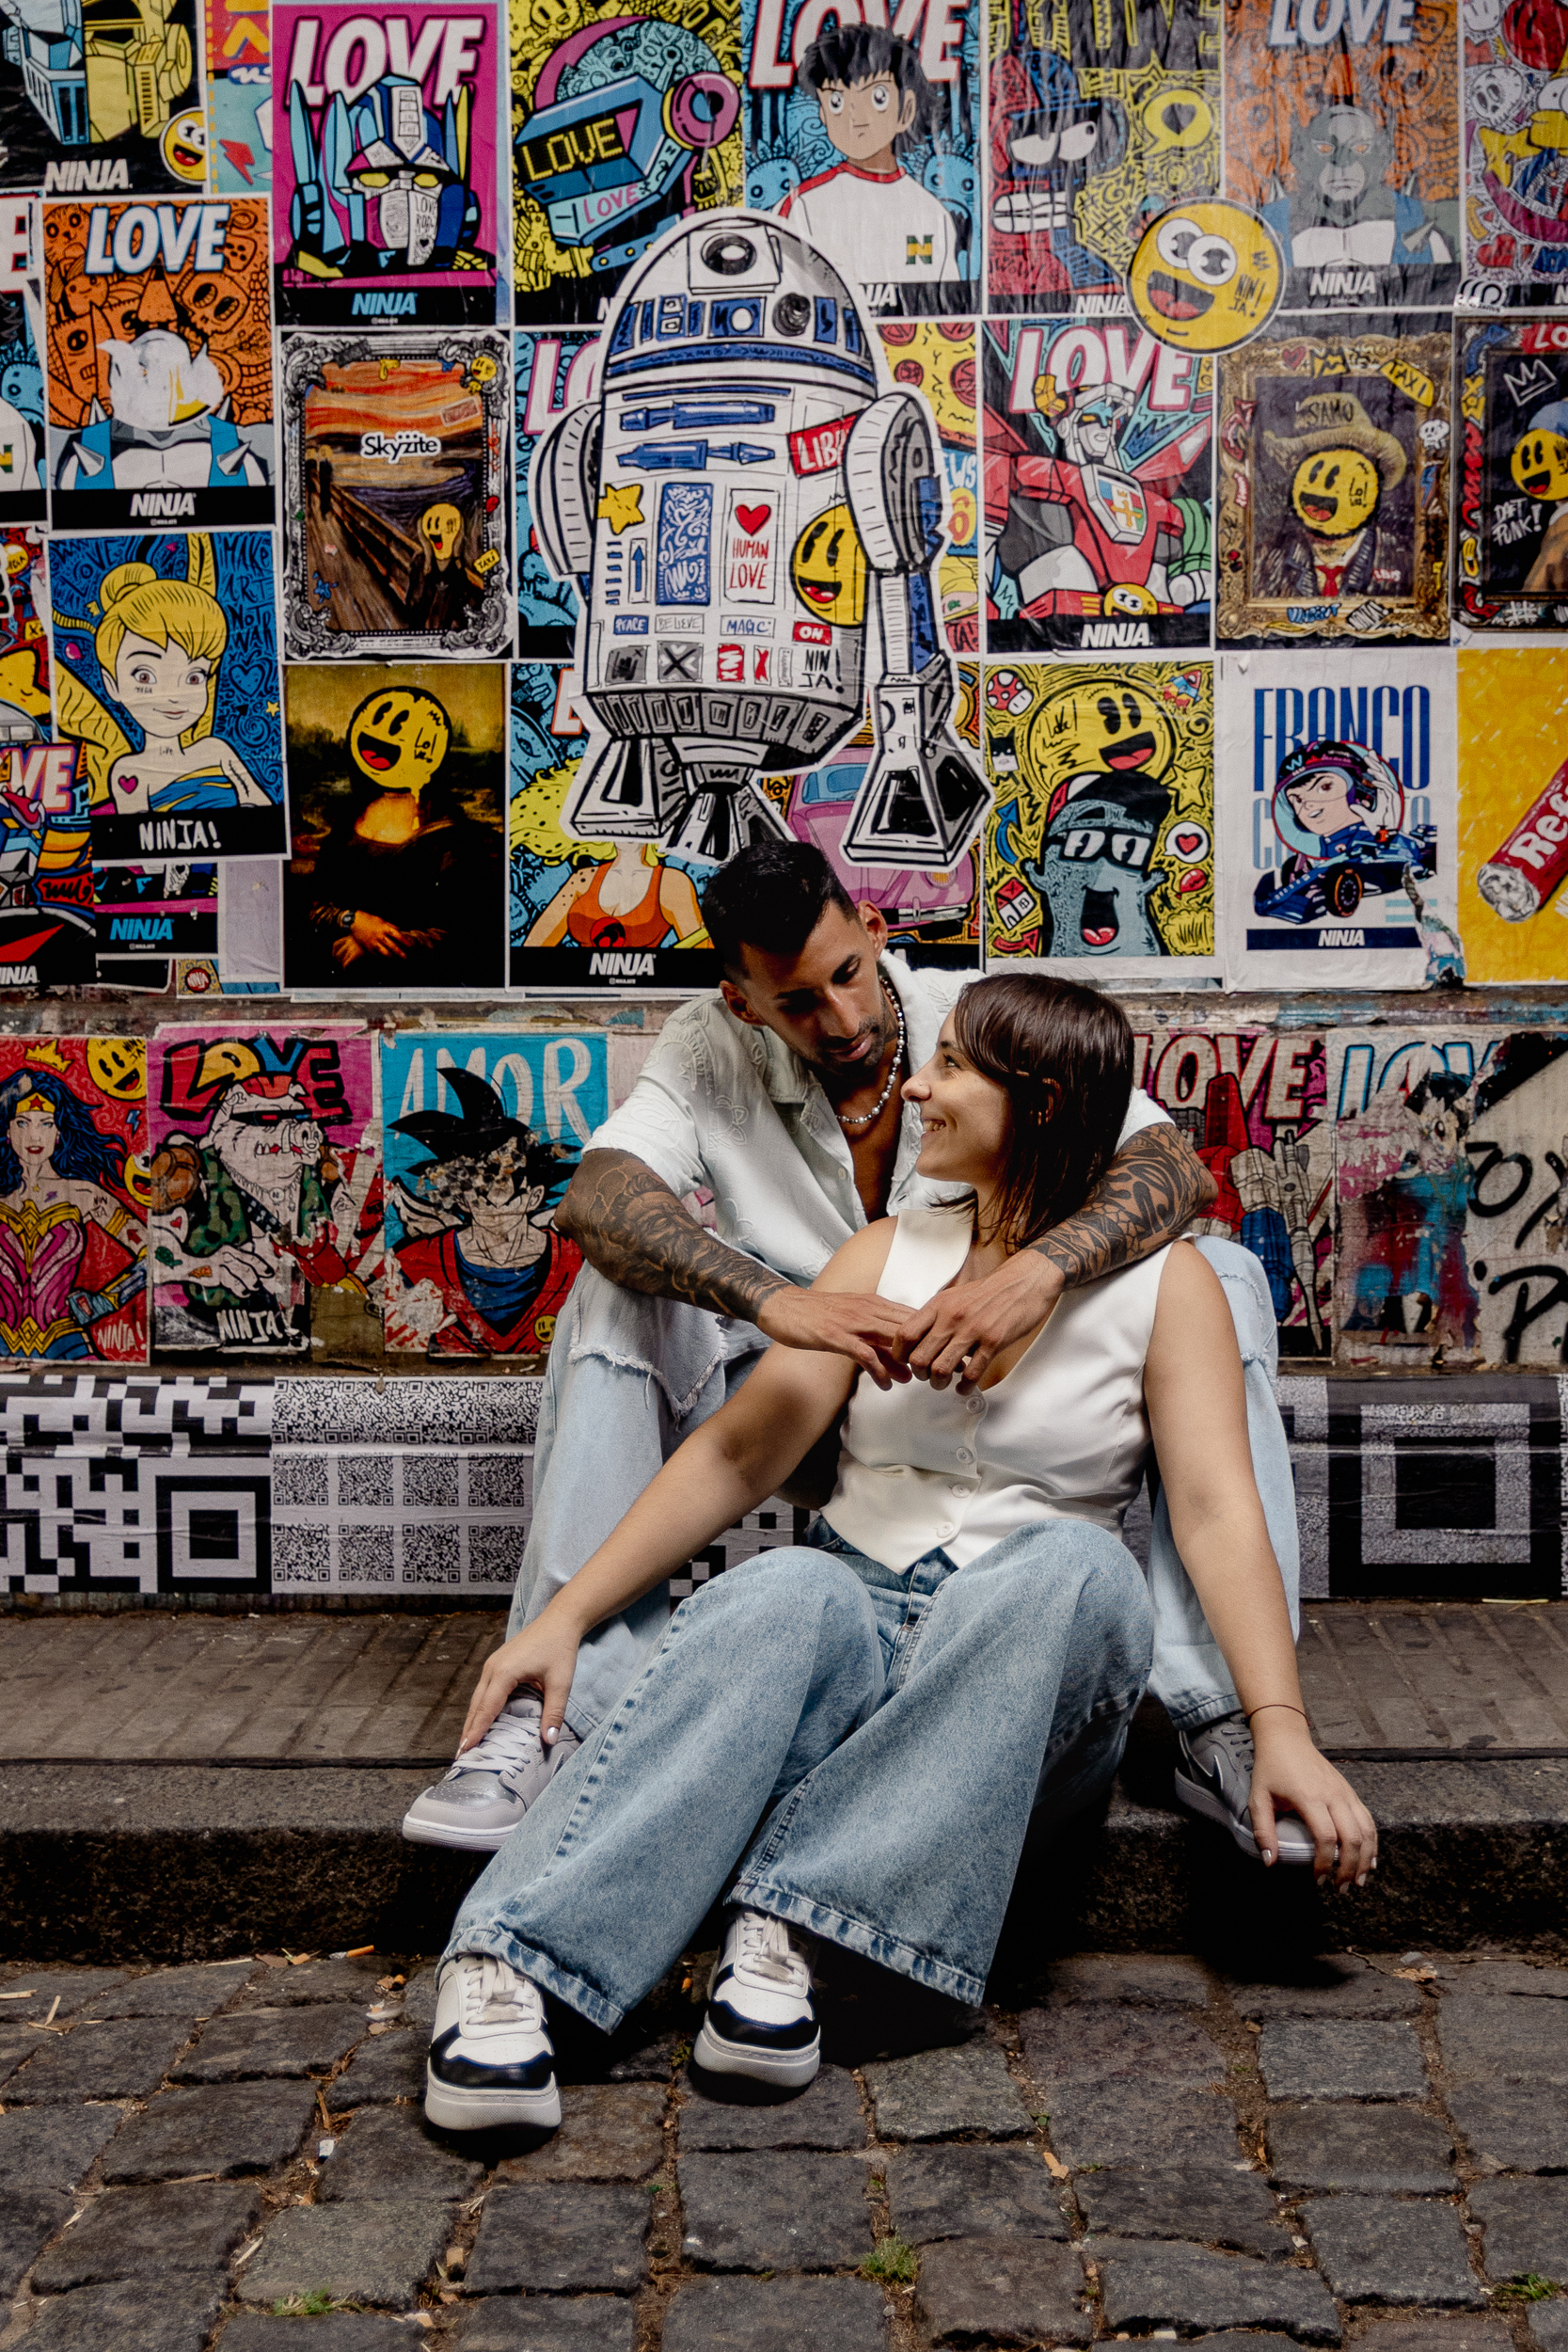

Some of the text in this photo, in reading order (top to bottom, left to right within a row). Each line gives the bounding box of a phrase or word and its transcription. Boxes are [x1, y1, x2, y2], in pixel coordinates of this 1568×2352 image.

[1269, 0, 1413, 45] LOVE
[285, 17, 485, 107] LOVE
[522, 119, 622, 180] LOVE
[583, 183, 641, 224] LOVE
[86, 204, 230, 274] LOVE
[1310, 272, 1376, 295] NINJA
[352, 293, 417, 316] NINJA
[1076, 294, 1129, 314] NINJA
[1009, 326, 1193, 413] LOVE
[1386, 359, 1427, 399] TAXI
[1308, 402, 1354, 423] SAMO
[363, 433, 439, 460] Skyzite
[130, 494, 195, 516] NINJA
[732, 540, 769, 560] HUMAN
[729, 563, 768, 591] LOVE
[657, 615, 701, 631] BELIEVE
[726, 618, 770, 633] MAGIC
[799, 626, 824, 640] ON
[139, 818, 221, 850] NINJA!
[110, 918, 174, 941] NINJA
[1318, 930, 1366, 946] NINJA
[589, 953, 656, 976] NINJA
[160, 1030, 353, 1124] LOVE
[394, 1038, 593, 1145] AMOR
[97, 1319, 147, 1354] NINJA!
[216, 1309, 282, 1343] NINJA
